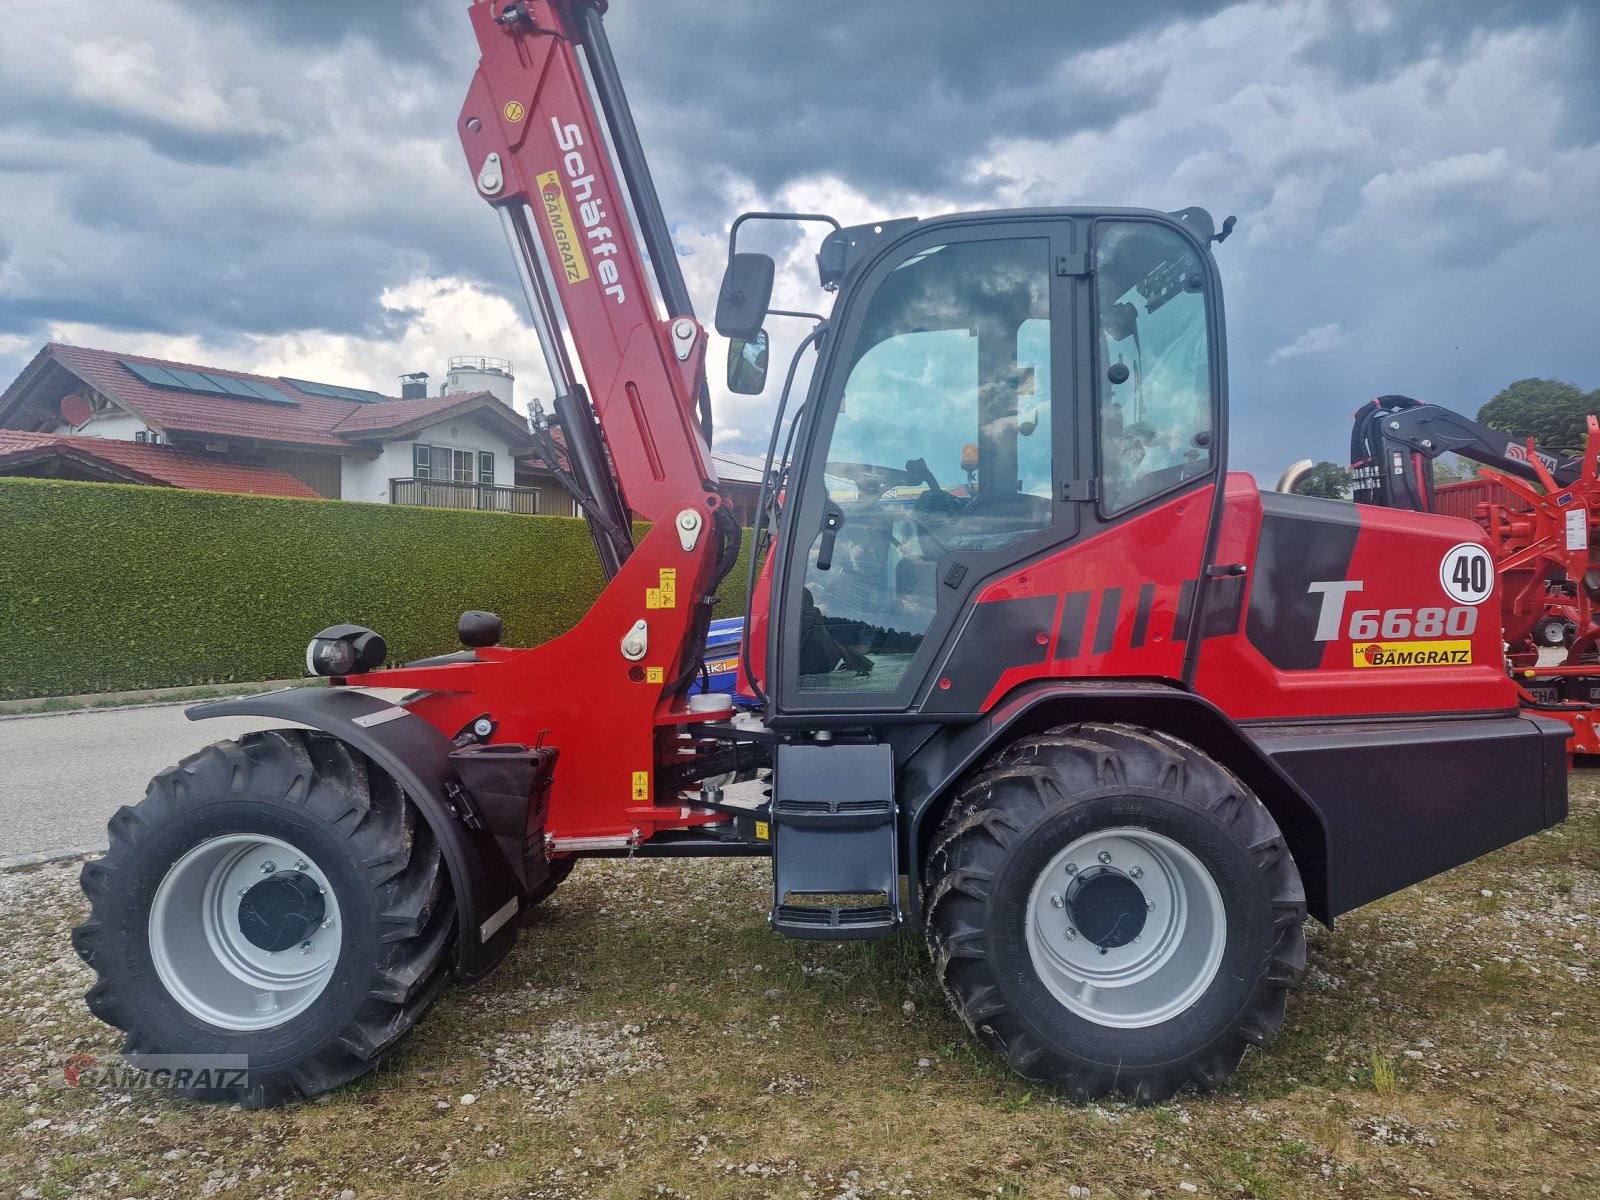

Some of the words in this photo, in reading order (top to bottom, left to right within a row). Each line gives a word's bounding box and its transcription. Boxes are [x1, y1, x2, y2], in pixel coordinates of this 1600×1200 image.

[542, 191, 581, 280] BAMGRATZ
[550, 116, 626, 304] Schäffer
[1452, 555, 1487, 593] 40
[1372, 650, 1470, 666] BAMGRATZ
